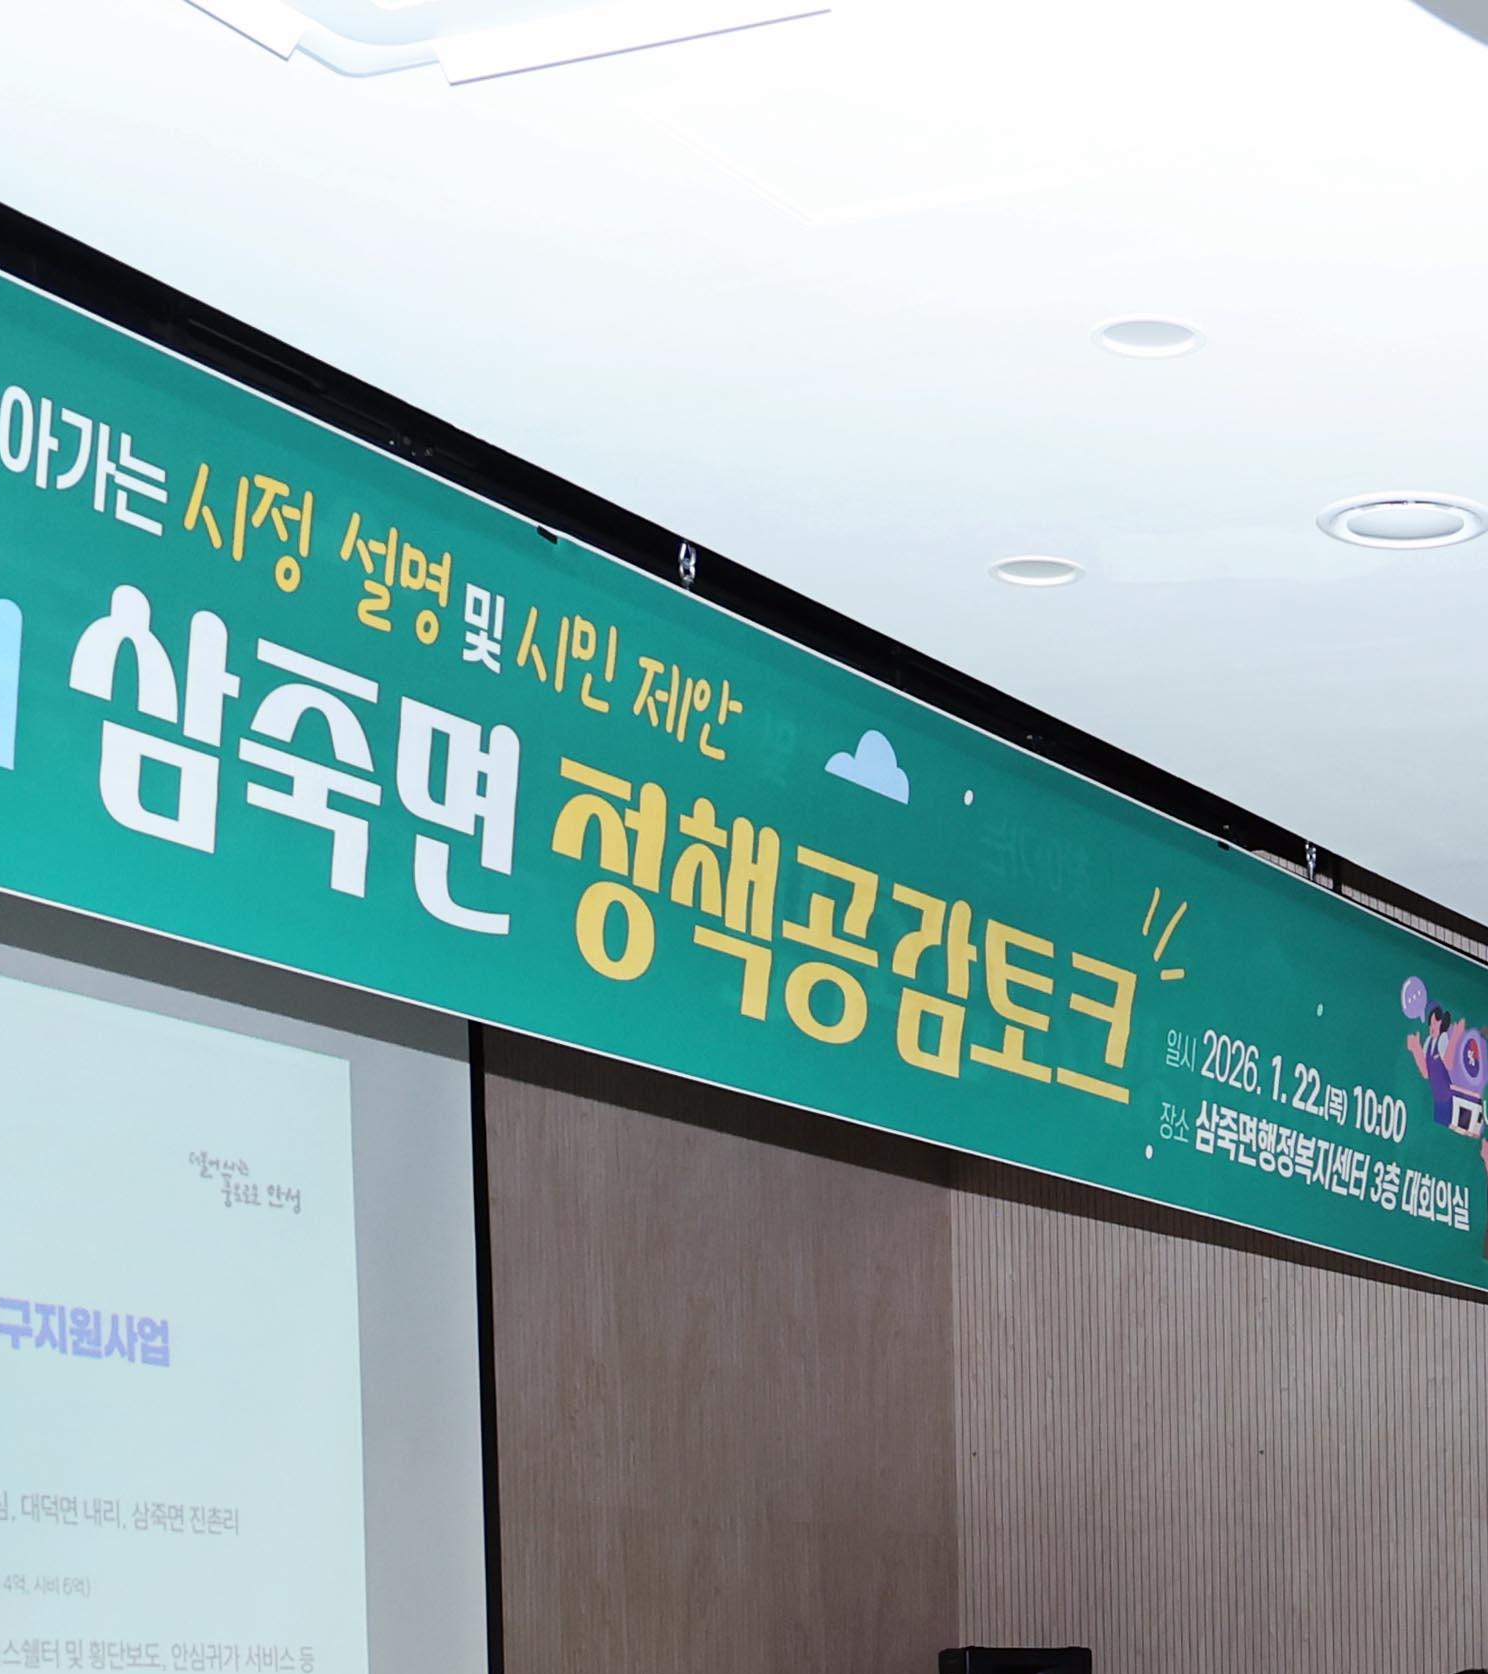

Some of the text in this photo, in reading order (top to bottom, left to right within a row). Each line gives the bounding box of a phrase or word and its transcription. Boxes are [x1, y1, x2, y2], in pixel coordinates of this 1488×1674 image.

[183, 462, 315, 592] 시정
[339, 511, 451, 647] 설명
[462, 581, 505, 674] 및
[516, 606, 617, 713] 시민
[632, 655, 743, 762] 제안
[69, 584, 521, 936] 삼죽면
[550, 756, 1140, 1105] 정책공감토크
[1165, 1028, 1407, 1143] 일시 2026. 1. 22.(목) 10:00
[266, 1183, 302, 1215] 안성
[1159, 1100, 1470, 1232] 장소 삼죽면행정복지센터 3층 대회의실
[20, 1492, 79, 1527] 대덕면
[130, 1502, 186, 1535] 삼죽면
[64, 1639, 85, 1671] 및
[170, 1642, 241, 1674] 안심귀가
[244, 1645, 296, 1674] 서비스
[298, 1645, 316, 1674] 등
